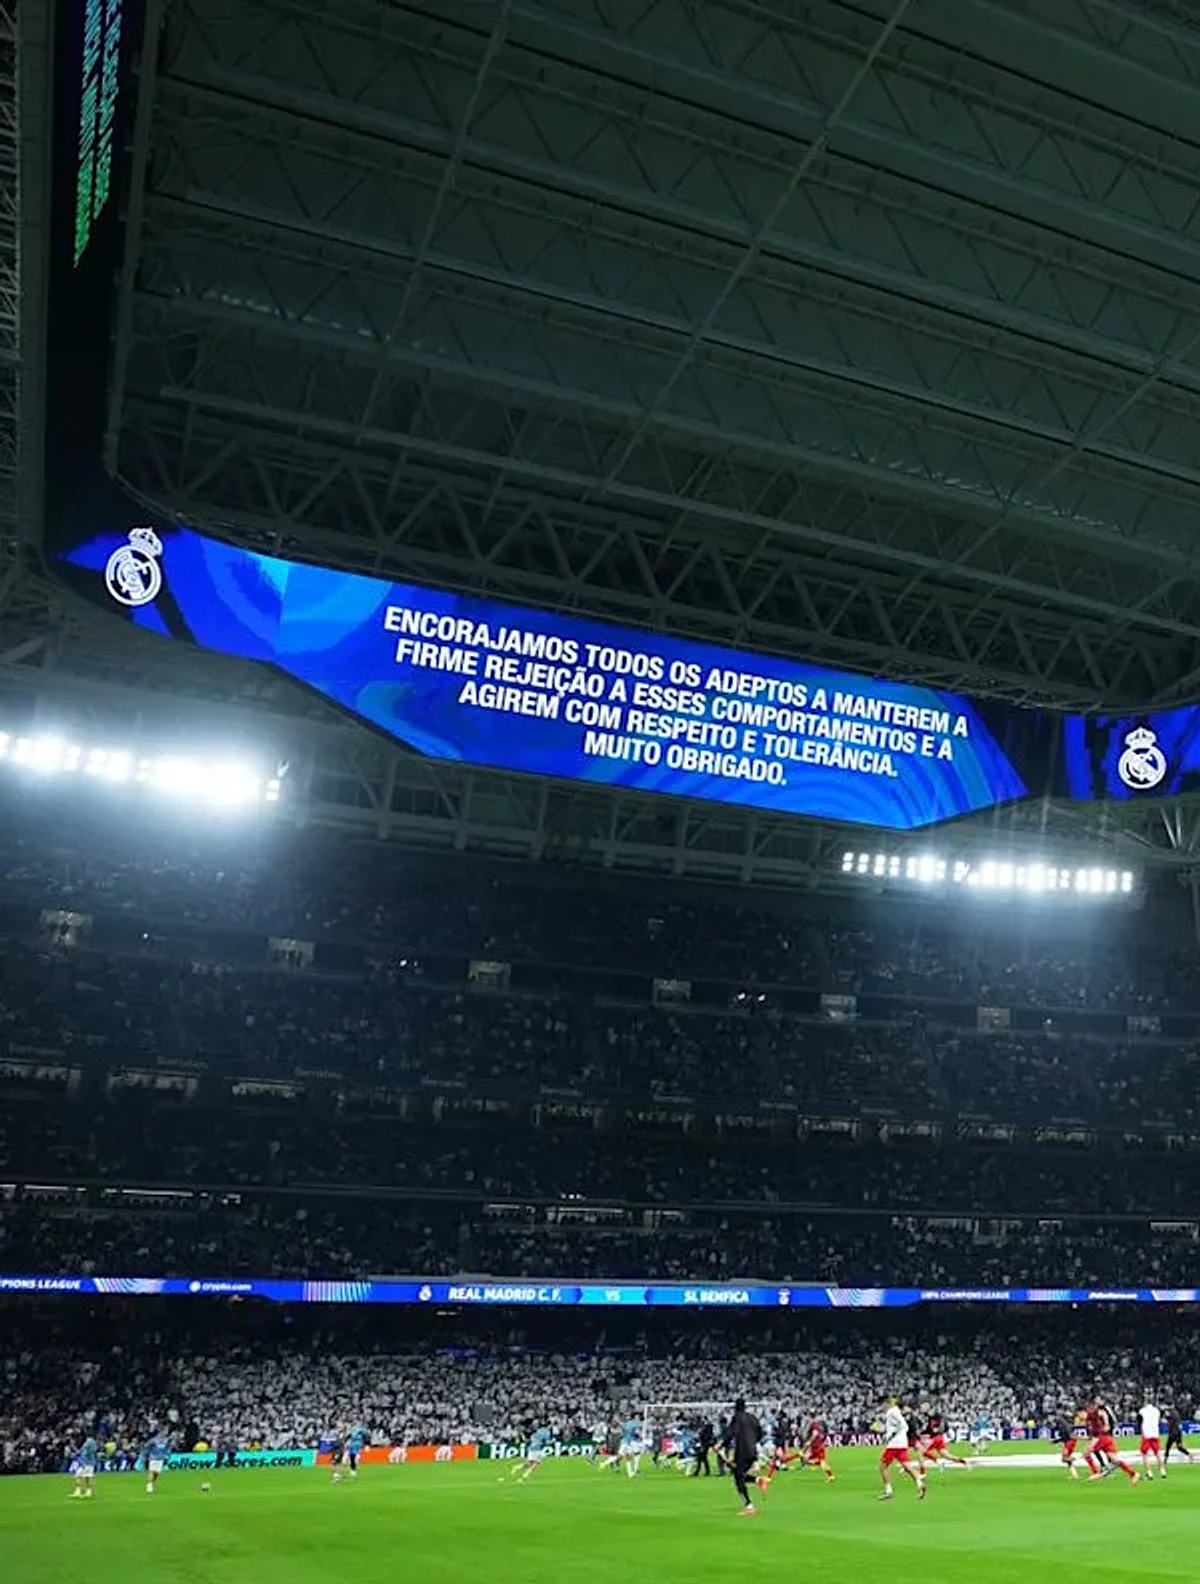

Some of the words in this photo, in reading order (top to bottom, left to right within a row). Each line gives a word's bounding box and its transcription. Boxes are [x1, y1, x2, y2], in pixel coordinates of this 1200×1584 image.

[384, 606, 579, 664] ENCORAJAMOS
[585, 644, 664, 681] TODOS
[669, 660, 701, 687] OS
[704, 668, 808, 707] ADEPTOS
[811, 689, 827, 711] A
[833, 692, 950, 734] MANTEREM
[953, 716, 968, 737] A
[396, 638, 479, 675] FIRME
[484, 654, 605, 699] REJEIÇÃO
[609, 679, 627, 702] A
[633, 682, 705, 716] ESSES
[712, 696, 916, 753] COMPORTAMENTOS
[921, 739, 935, 757] E
[937, 739, 953, 761] A
[459, 681, 559, 720] AGIREM
[565, 701, 621, 730] COM
[626, 710, 737, 750] RESPEITO
[742, 731, 757, 753] E
[763, 732, 898, 777] TOLERÂNCIA.
[584, 731, 661, 765] MUITO
[667, 745, 787, 786] OBRIGADO.
[38, 1279, 81, 1290] LEAGUE
[448, 1287, 482, 1301] REAL
[484, 1287, 536, 1301] MADRID
[700, 1289, 749, 1304] BENFICA
[491, 1442, 593, 1459] Heieken
